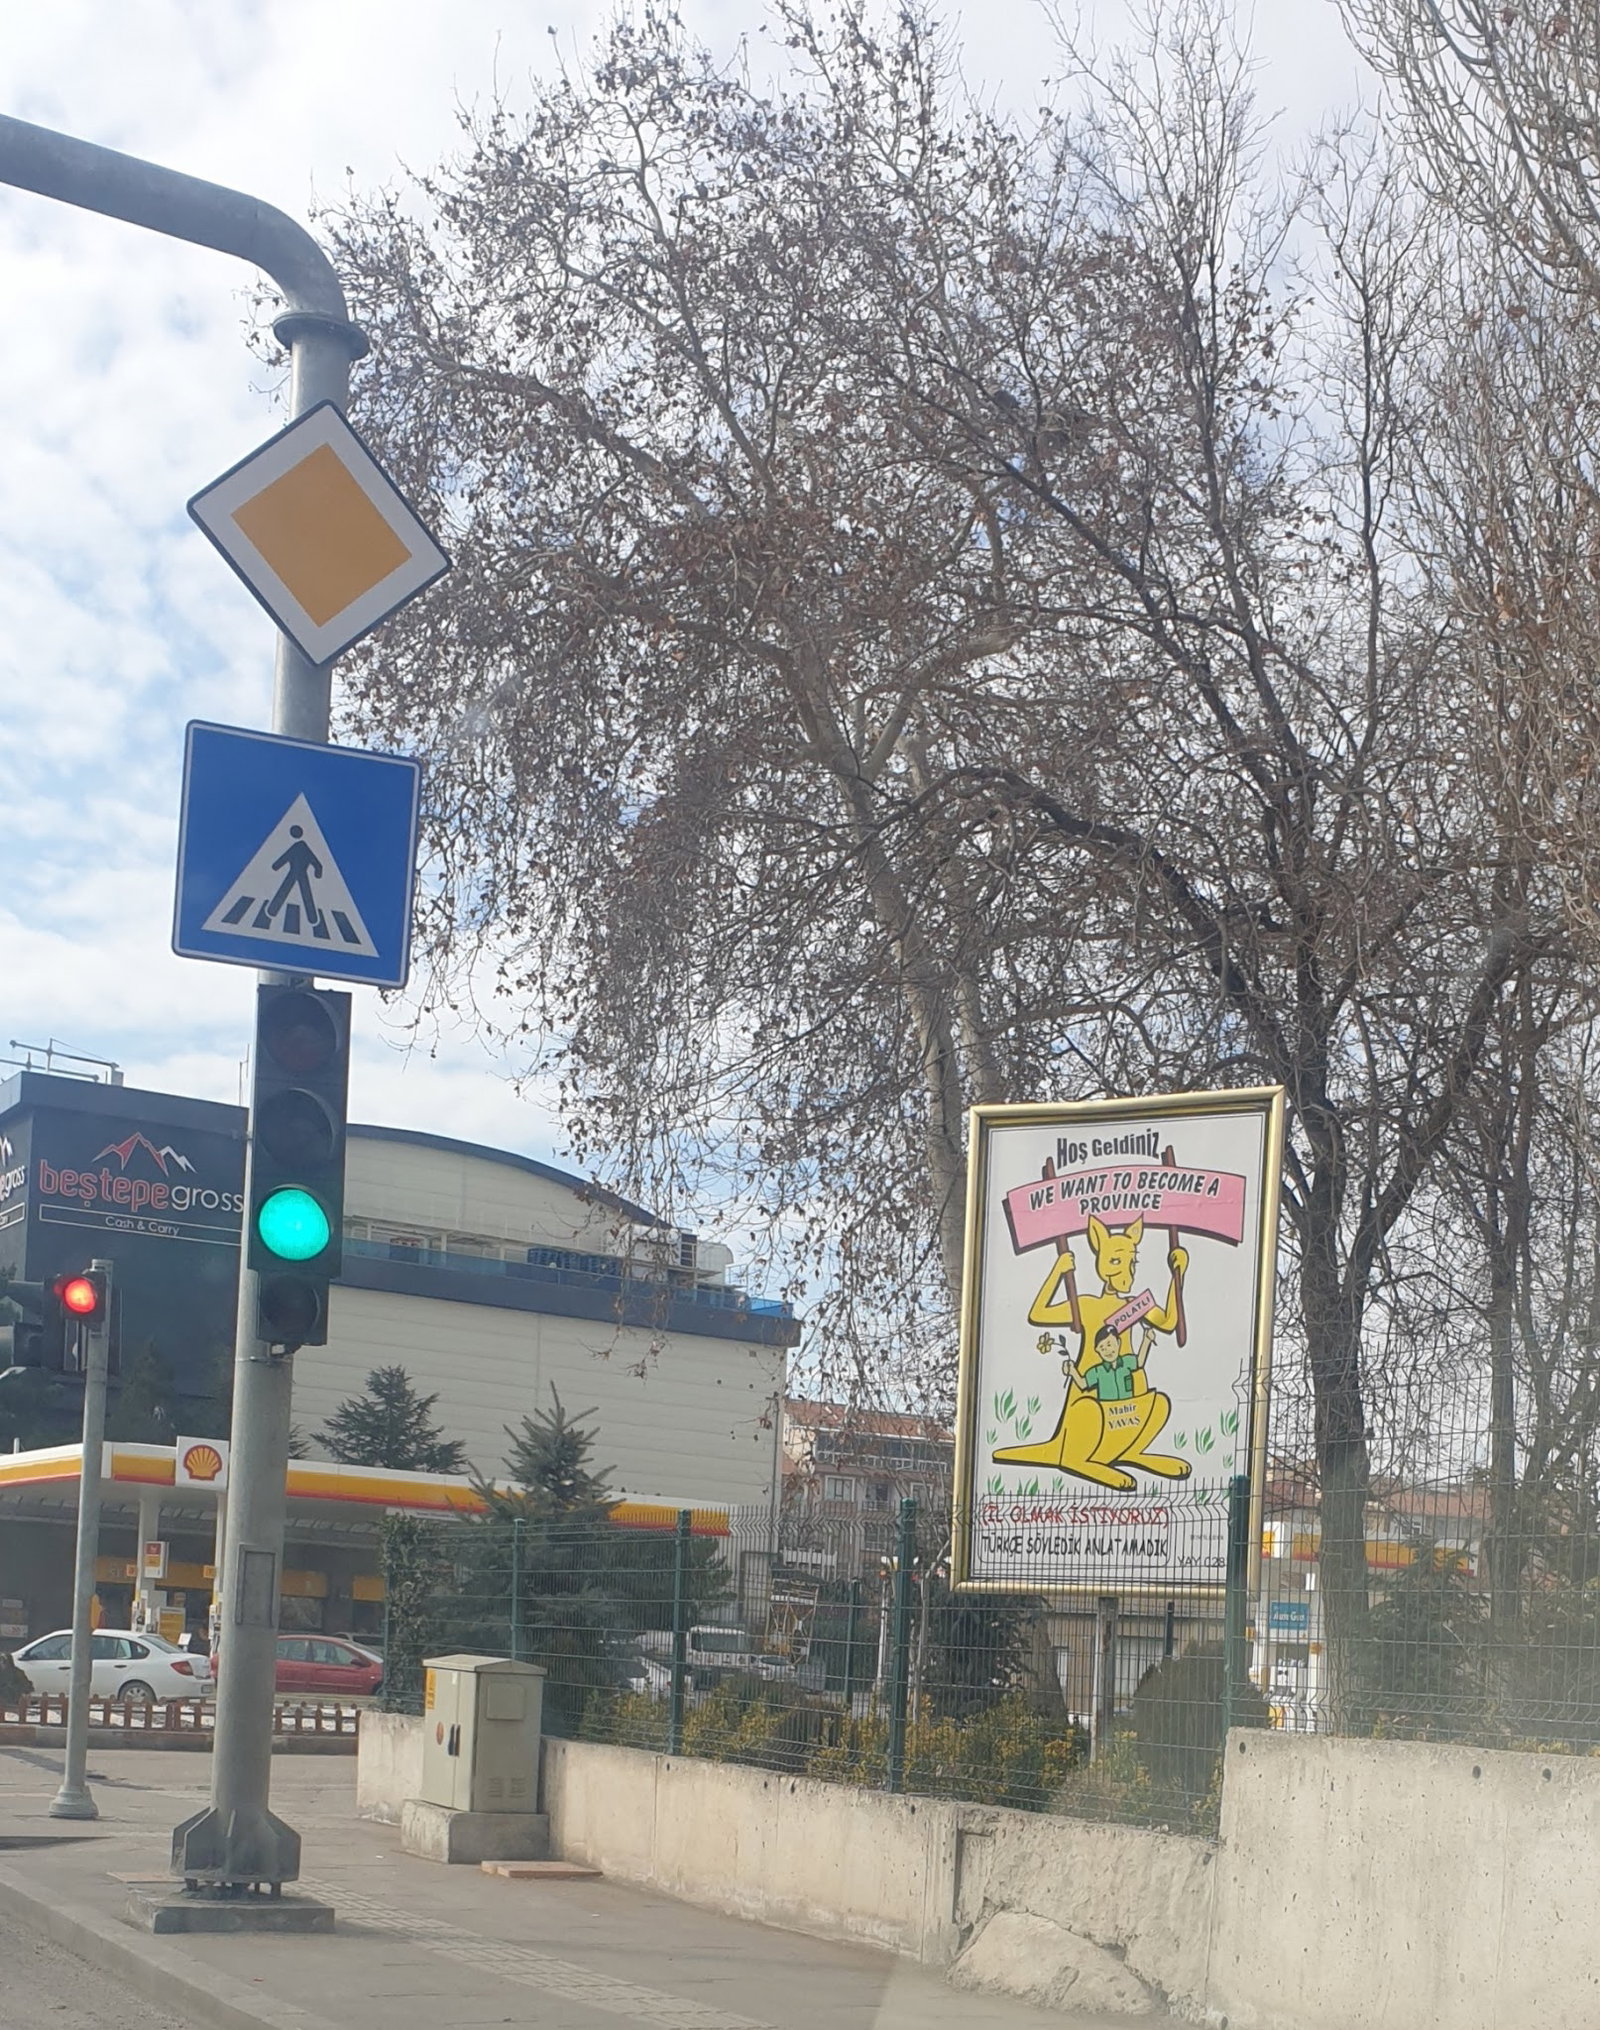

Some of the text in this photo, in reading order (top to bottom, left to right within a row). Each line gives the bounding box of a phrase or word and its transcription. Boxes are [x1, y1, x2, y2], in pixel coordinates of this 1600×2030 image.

[1056, 1137, 1088, 1169] Hoş
[1029, 1171, 1220, 1211] WE WANT TO BECOME A
[1079, 1193, 1162, 1216] PROVINCE
[105, 1215, 180, 1236] Cash & Carry
[1114, 1294, 1153, 1326] POLATLI
[1108, 1404, 1137, 1416] Mahir
[1010, 1504, 1064, 1524] OLMAK
[981, 1532, 1023, 1557] TÜRKÇE
[1085, 1537, 1167, 1557] ANLATAMADIK
